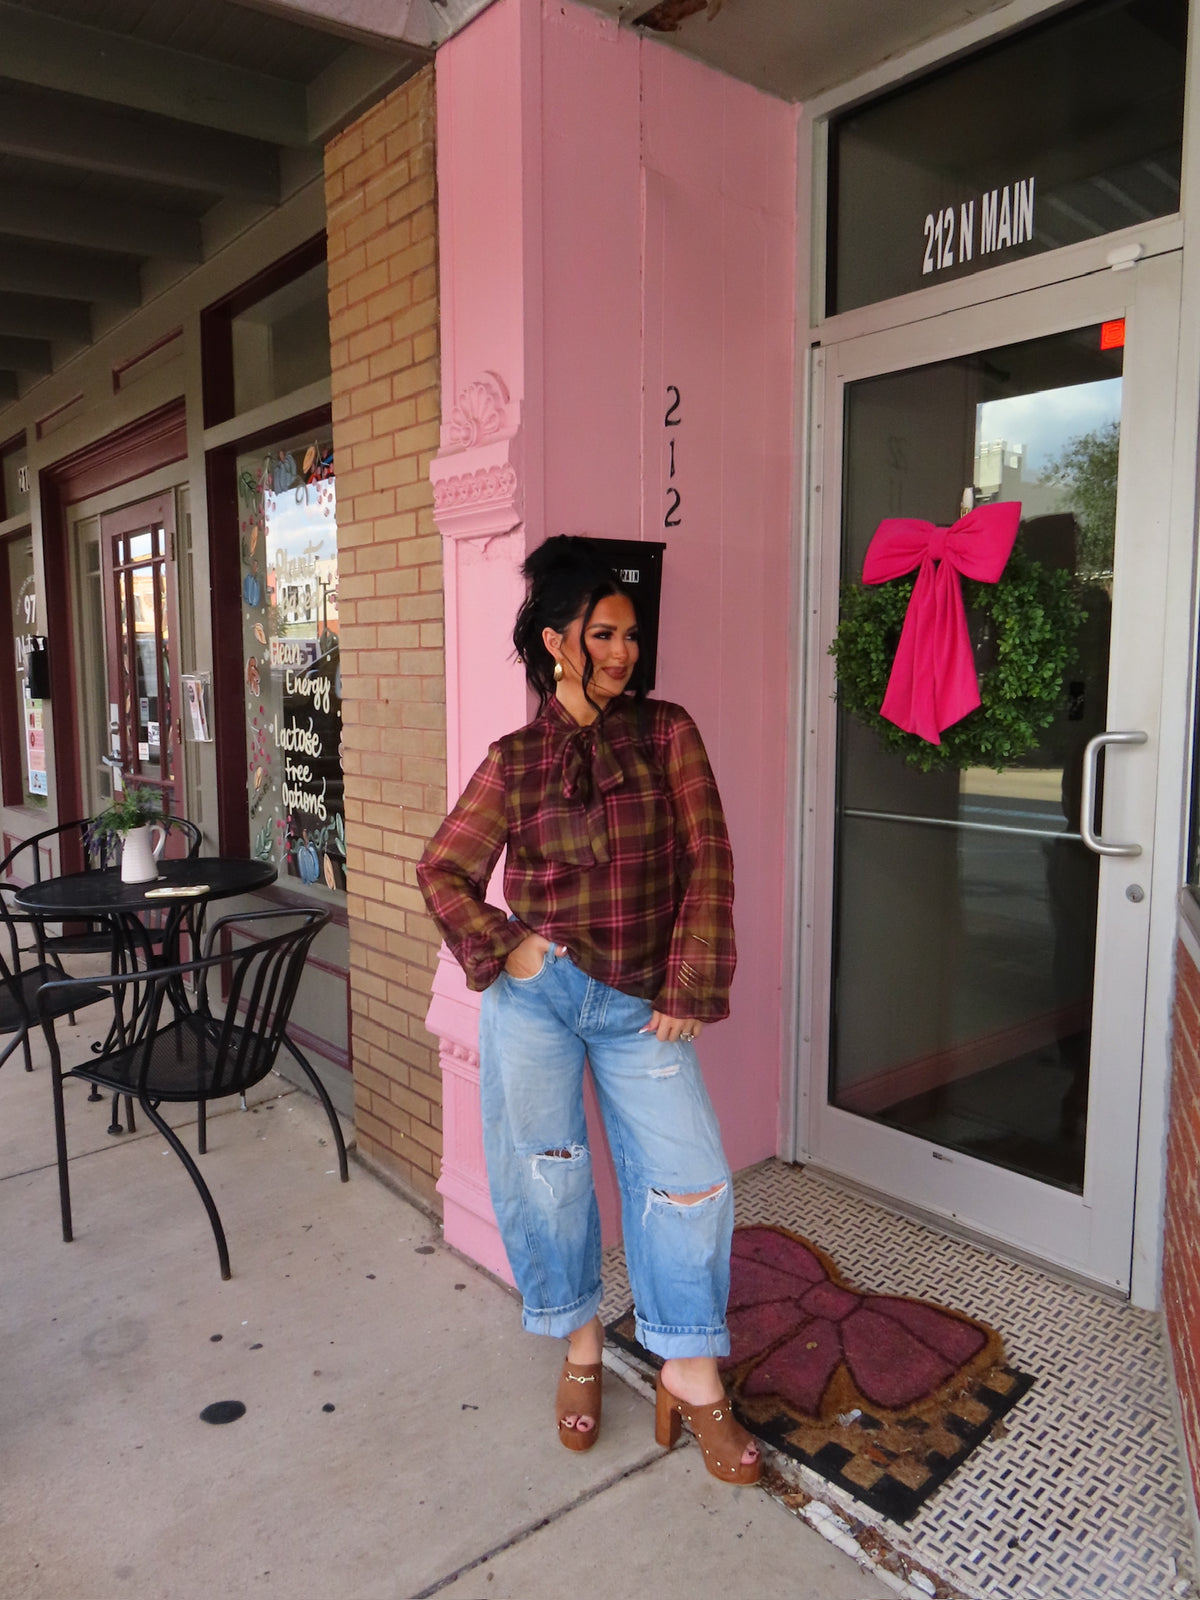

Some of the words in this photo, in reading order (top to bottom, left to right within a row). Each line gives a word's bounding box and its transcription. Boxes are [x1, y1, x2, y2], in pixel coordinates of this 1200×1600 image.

[922, 206, 955, 275] 212
[959, 200, 974, 263] N
[980, 176, 1035, 255] MAIN
[664, 385, 682, 528] 212
[285, 669, 331, 714] Energy
[274, 713, 323, 758] Lactose
[285, 757, 313, 783] Free
[282, 776, 327, 822] Options
